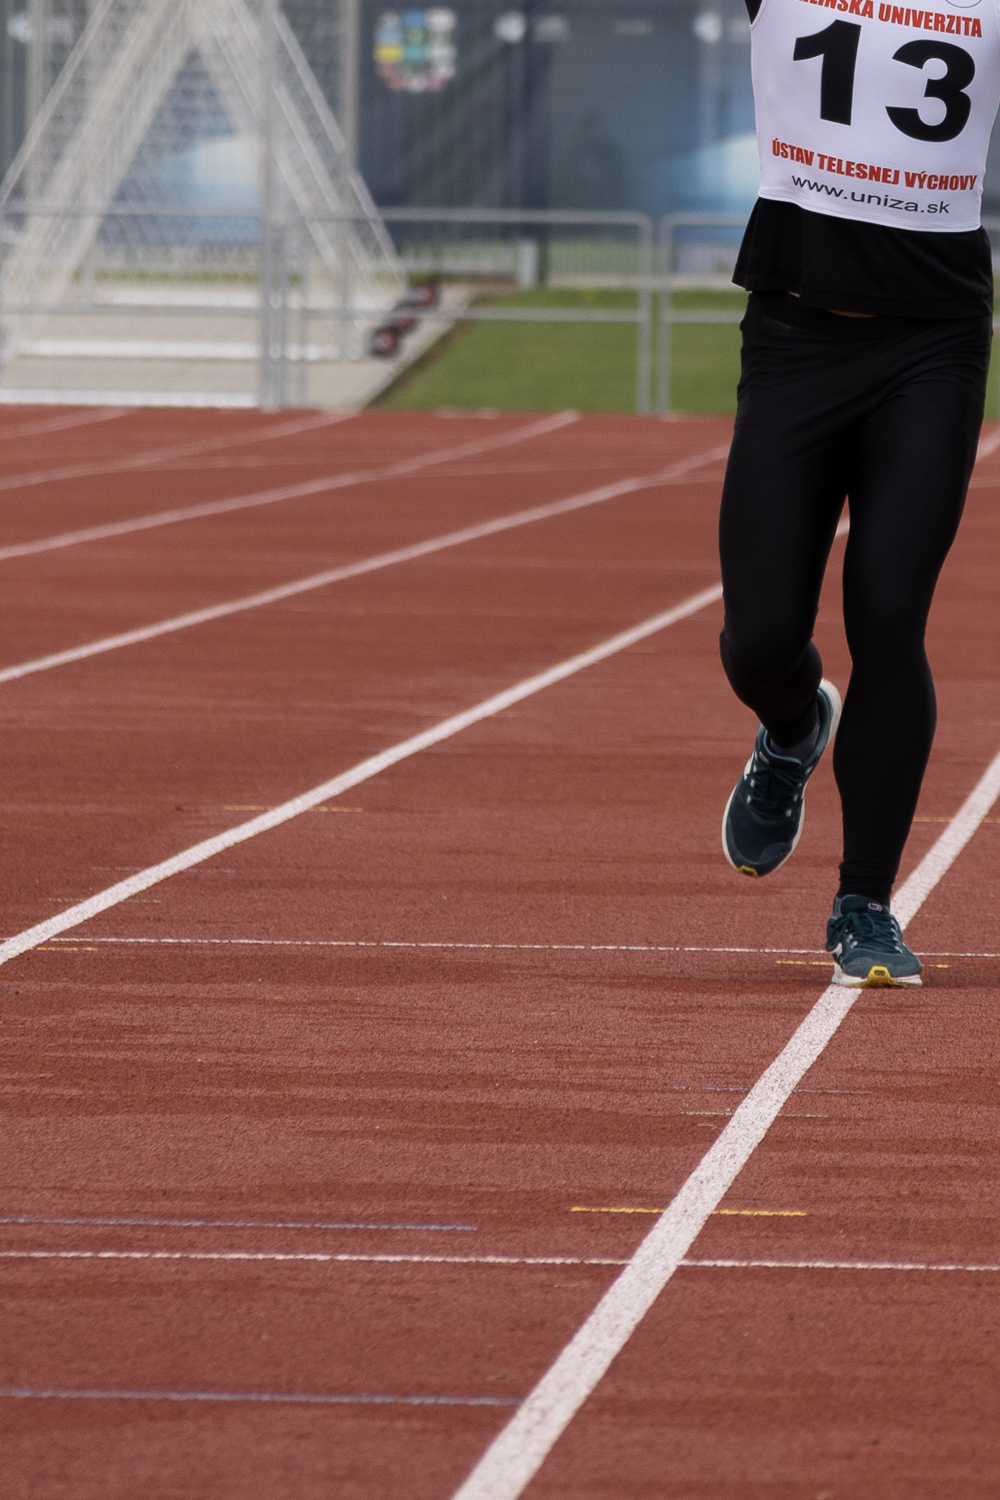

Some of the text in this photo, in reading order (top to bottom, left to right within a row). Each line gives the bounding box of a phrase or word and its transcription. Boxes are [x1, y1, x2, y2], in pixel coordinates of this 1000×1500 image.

[878, 3, 982, 38] UNIVERZITA
[792, 19, 976, 143] 13
[772, 138, 978, 191] ÚSTAV TELESNEJ VÝCHOVY
[791, 175, 950, 214] www.uniza.sk
